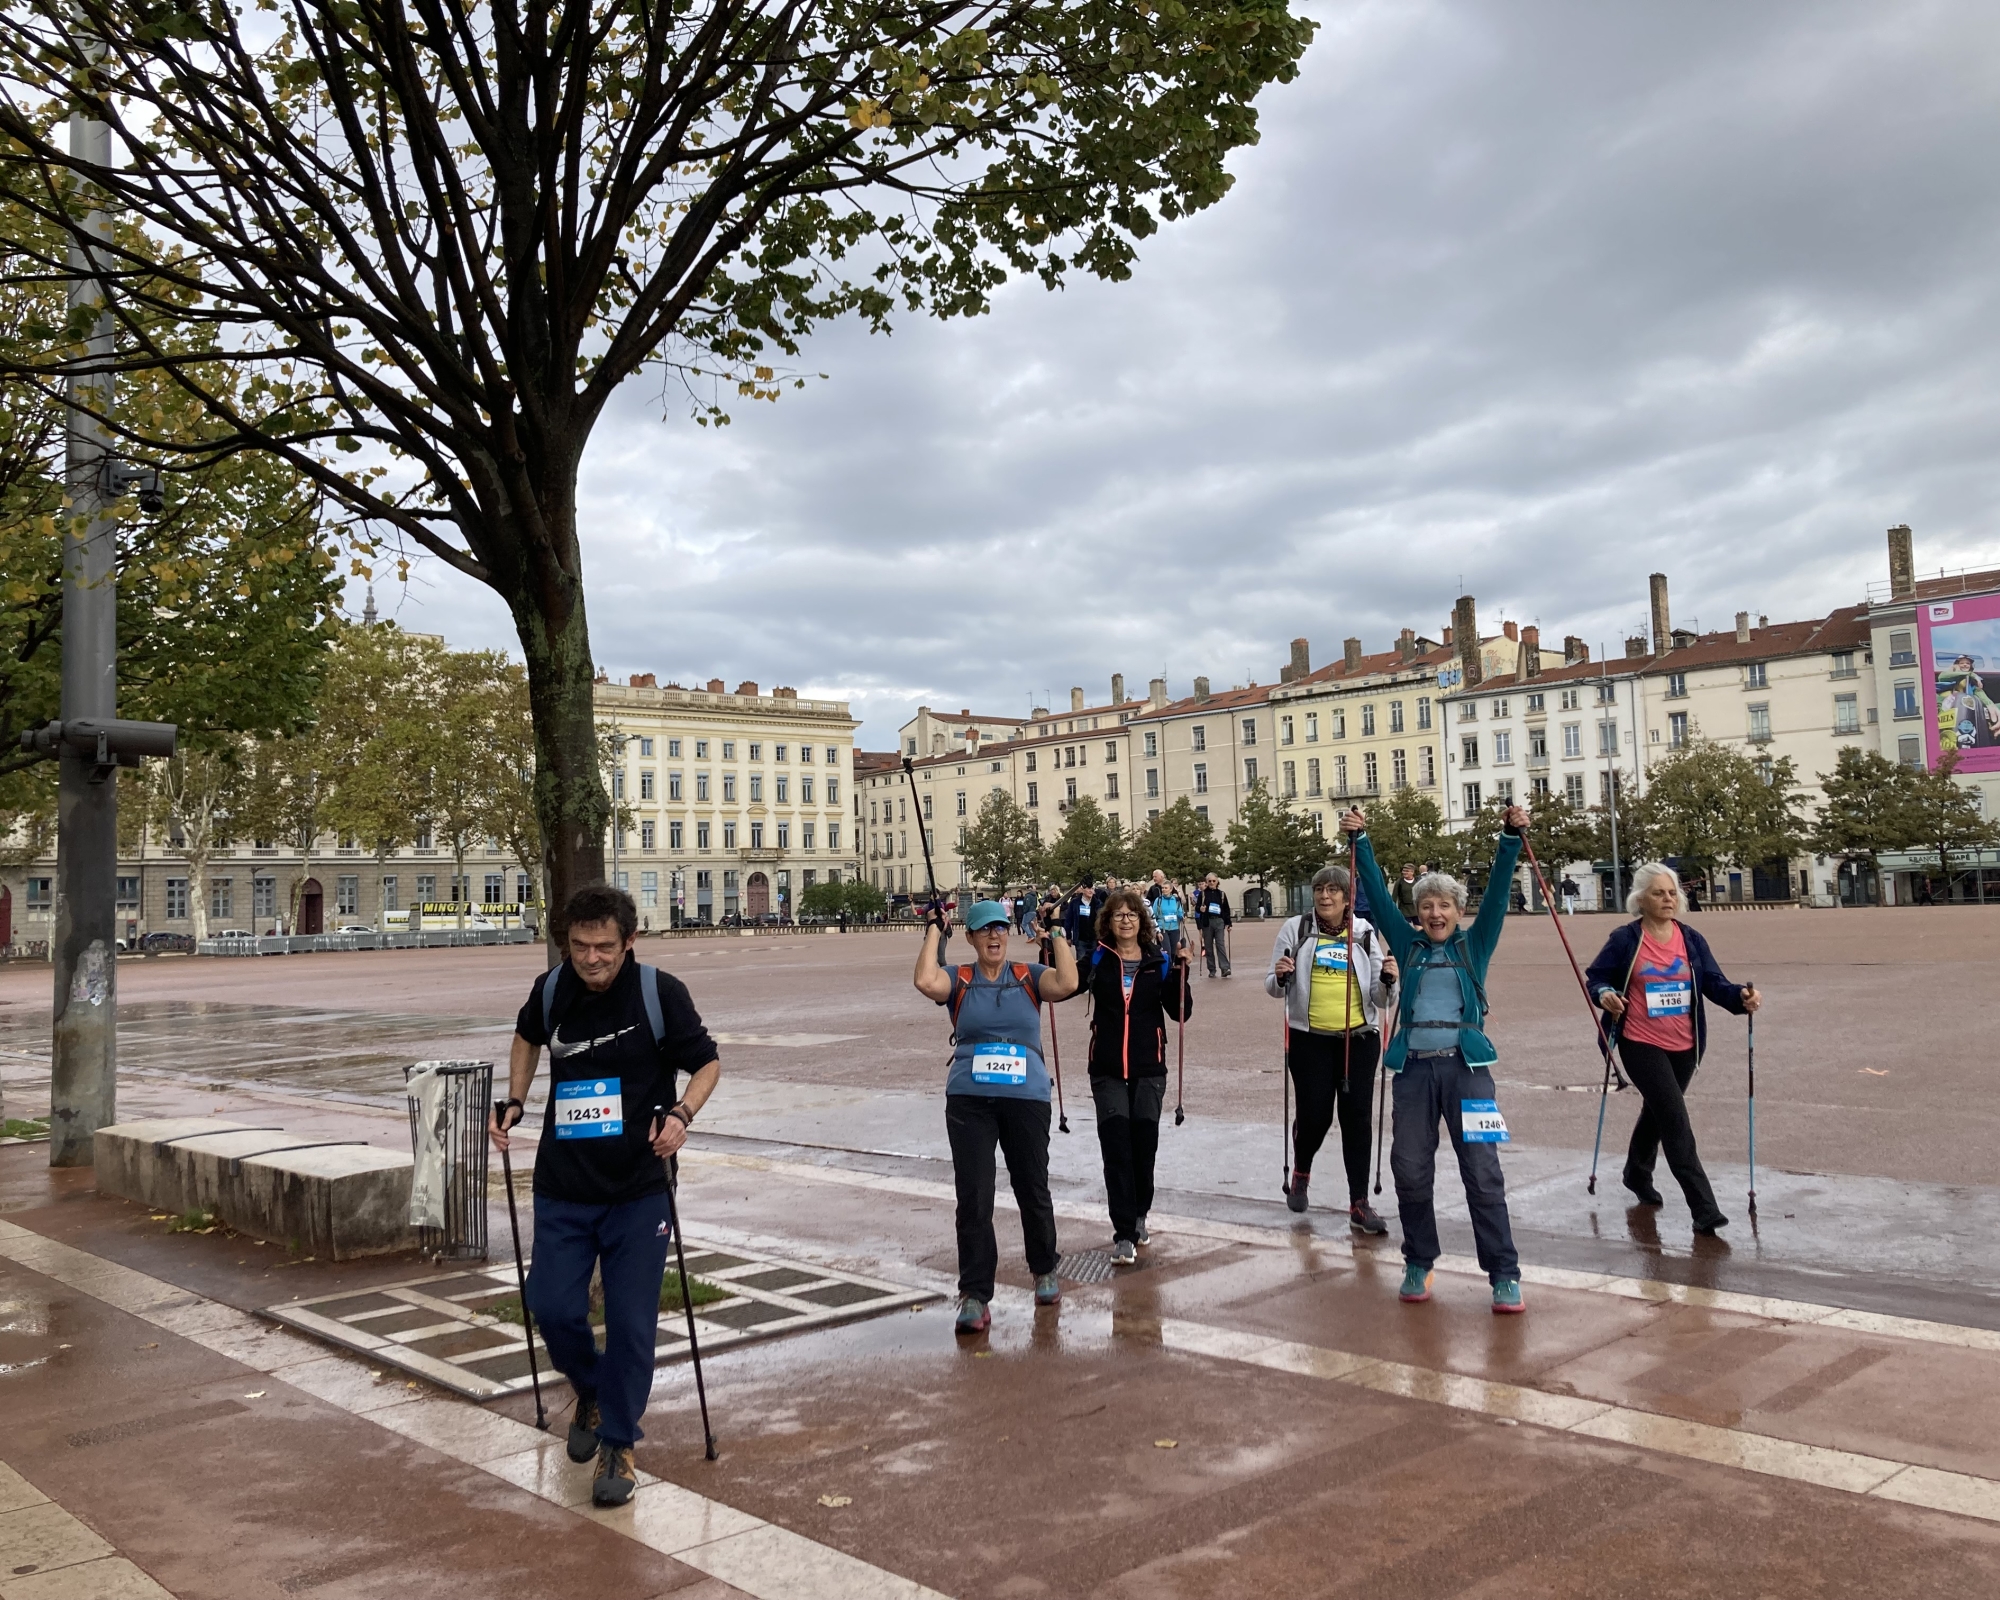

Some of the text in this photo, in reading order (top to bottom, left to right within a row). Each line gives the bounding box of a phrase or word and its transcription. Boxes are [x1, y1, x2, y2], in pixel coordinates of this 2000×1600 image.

[1908, 853, 1970, 863] FRANCE CAPÉ
[1327, 951, 1348, 961] 1255
[1660, 998, 1682, 1006] 1136
[986, 1061, 1012, 1071] 1247
[567, 1107, 601, 1121] 1243
[1478, 1120, 1501, 1129] 1246
